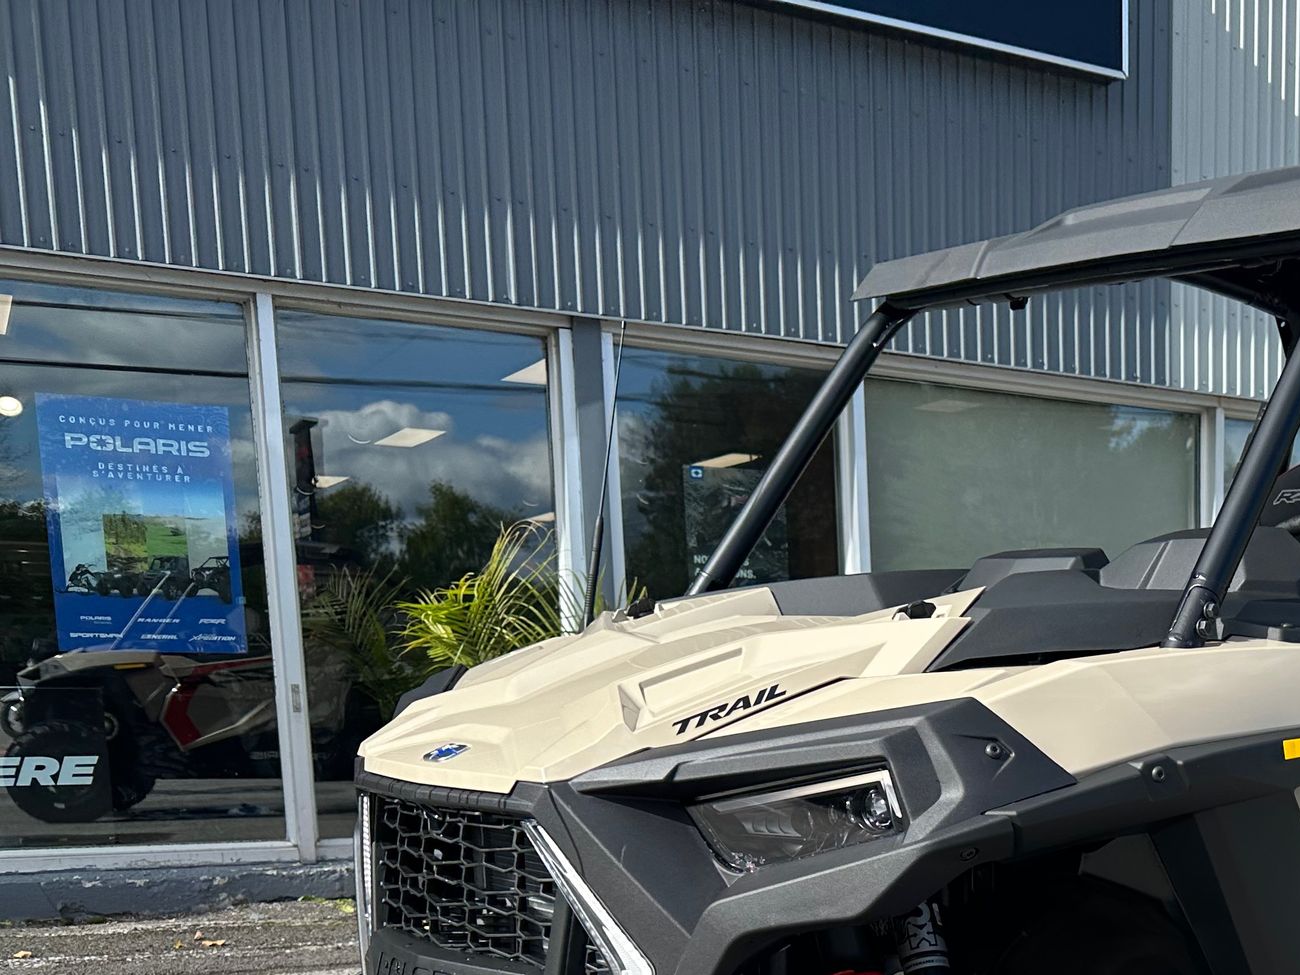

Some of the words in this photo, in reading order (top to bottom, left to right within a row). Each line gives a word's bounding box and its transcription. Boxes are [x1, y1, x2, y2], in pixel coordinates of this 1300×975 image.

[58, 414, 116, 427] CONÇUS
[124, 419, 160, 430] POUR
[168, 423, 214, 433] MENER
[64, 432, 210, 458] POLARIS
[92, 470, 191, 483] S'AVENTURER
[671, 683, 787, 736] TRAIL
